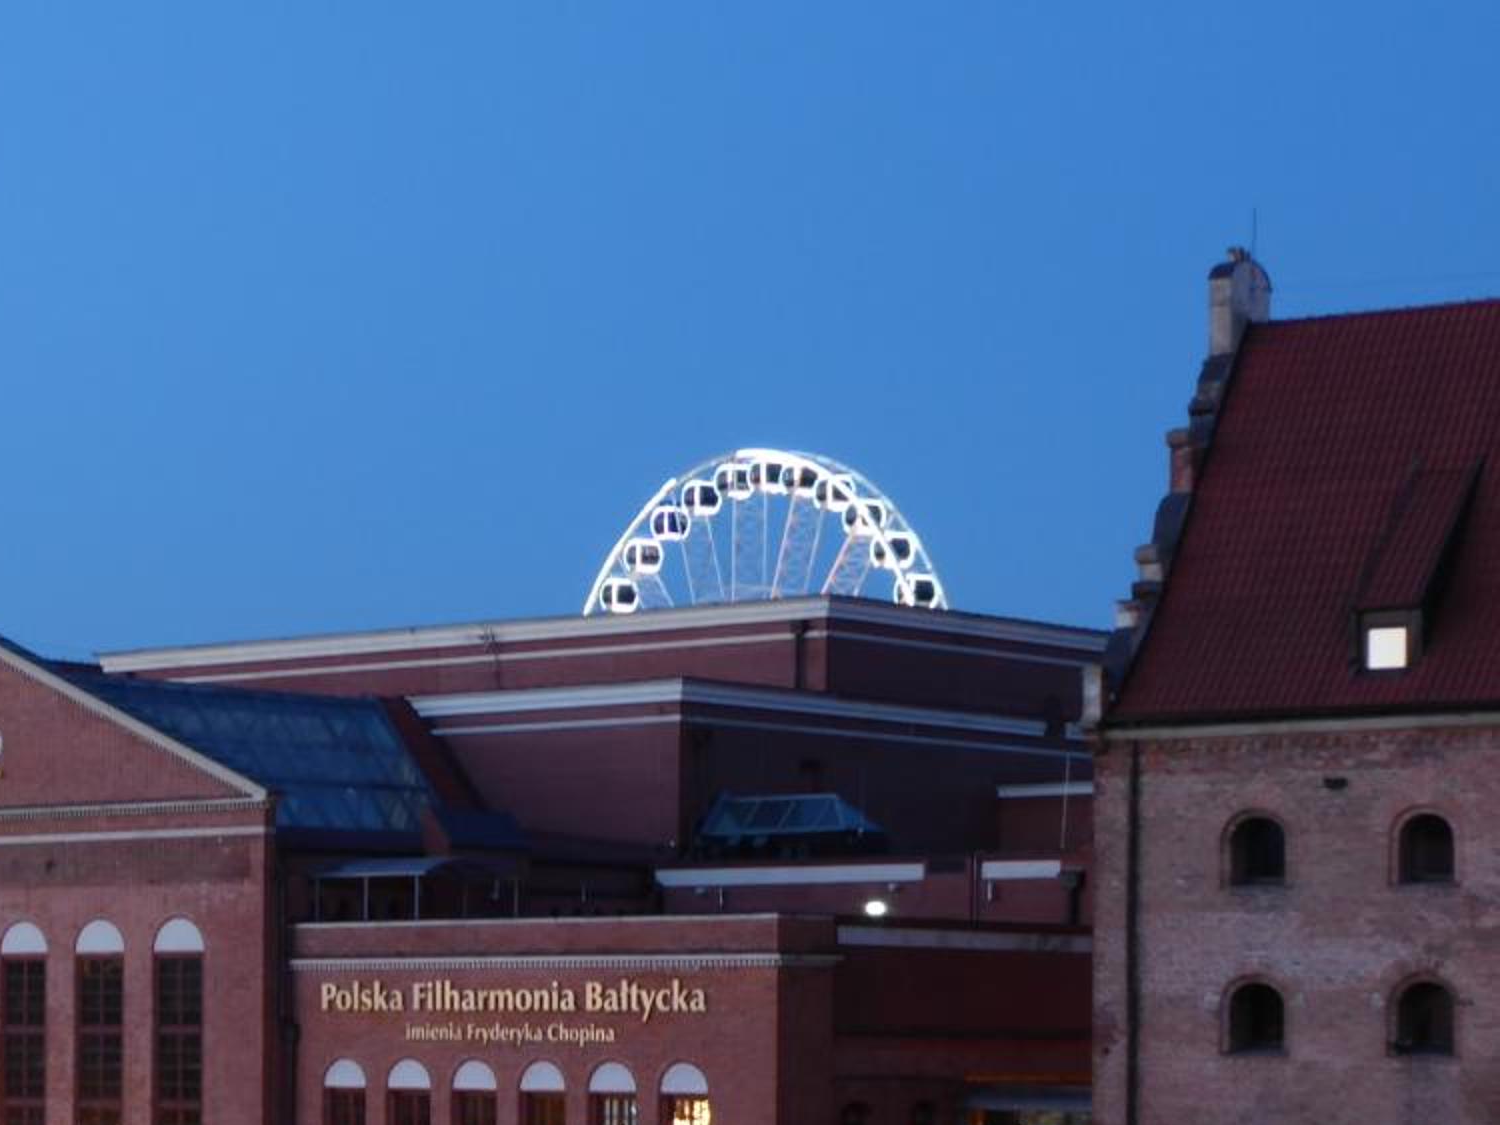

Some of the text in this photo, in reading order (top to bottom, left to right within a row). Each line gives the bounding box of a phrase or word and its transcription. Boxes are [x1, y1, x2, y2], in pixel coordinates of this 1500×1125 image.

[320, 978, 706, 1023] Polska Filharmonia Bałtycka
[405, 1022, 616, 1048] imienia Fryderyka Chopina
